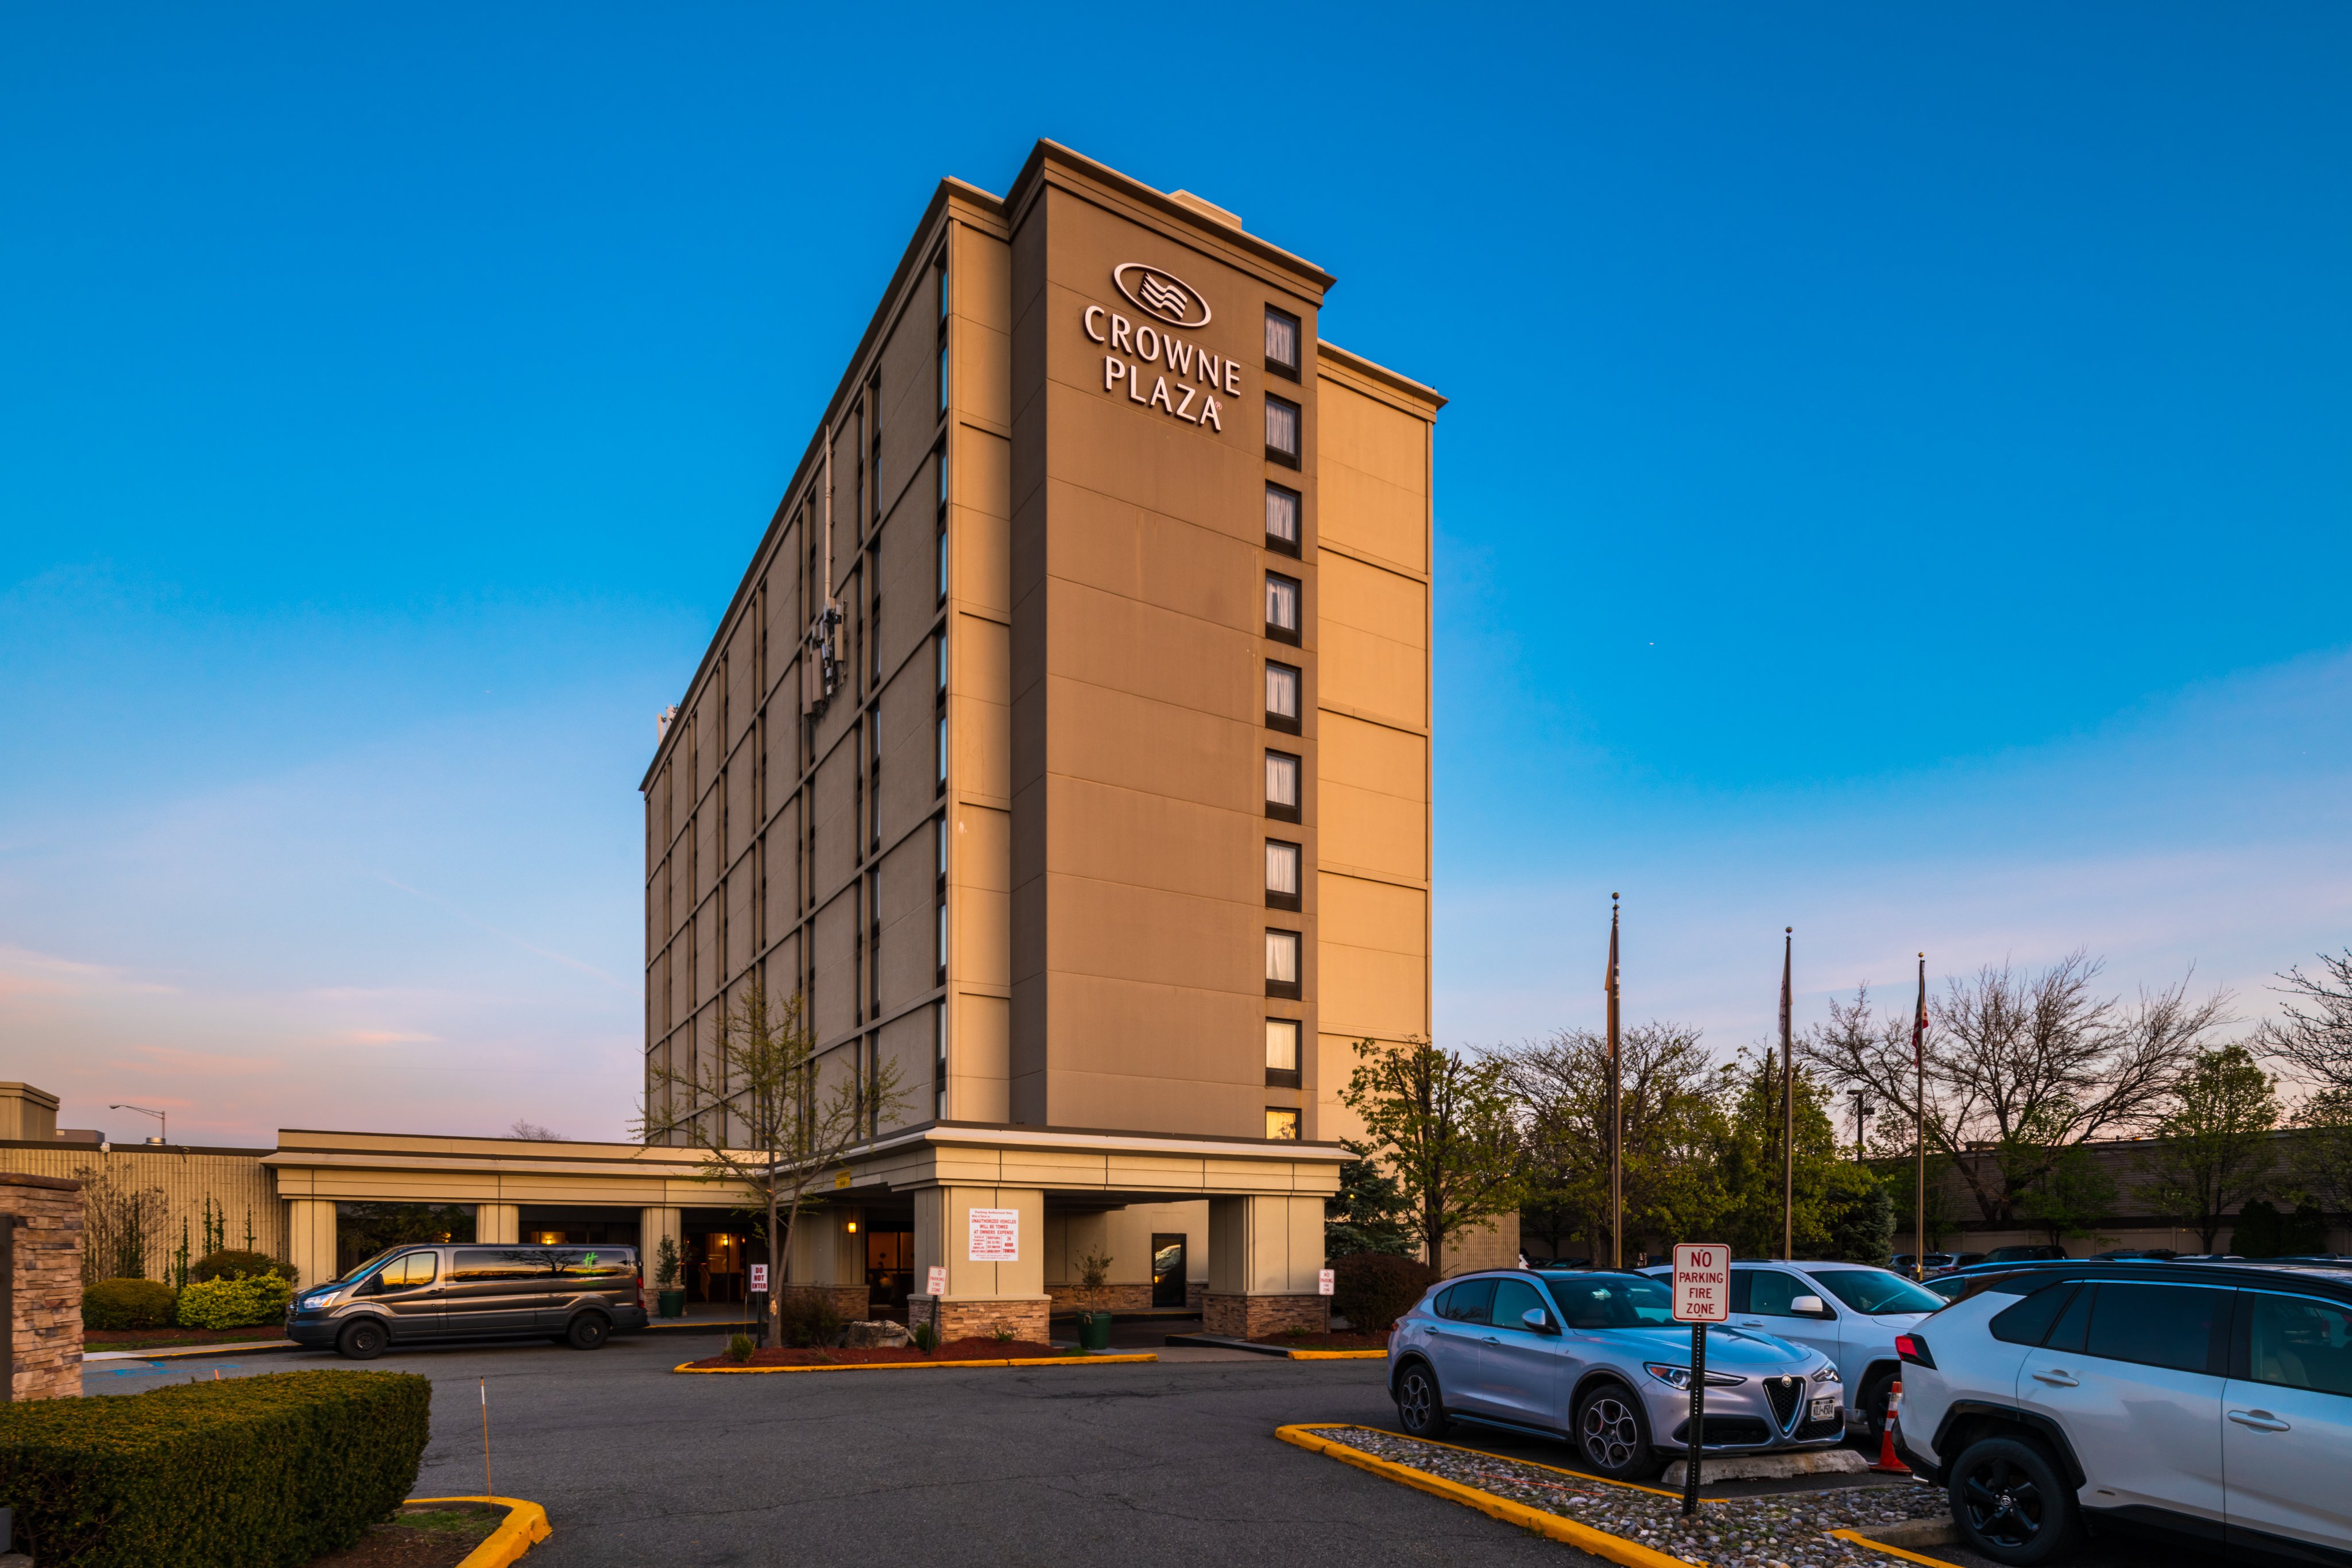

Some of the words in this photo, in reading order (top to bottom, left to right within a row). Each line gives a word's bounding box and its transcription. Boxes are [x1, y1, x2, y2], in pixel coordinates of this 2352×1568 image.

[1083, 305, 1241, 397] CROWNE
[1104, 354, 1221, 433] PLAZA
[1690, 1251, 1712, 1267] NO
[1679, 1272, 1723, 1284] PARKING
[1689, 1288, 1712, 1299] FIRE
[1686, 1303, 1715, 1314] ZONE
